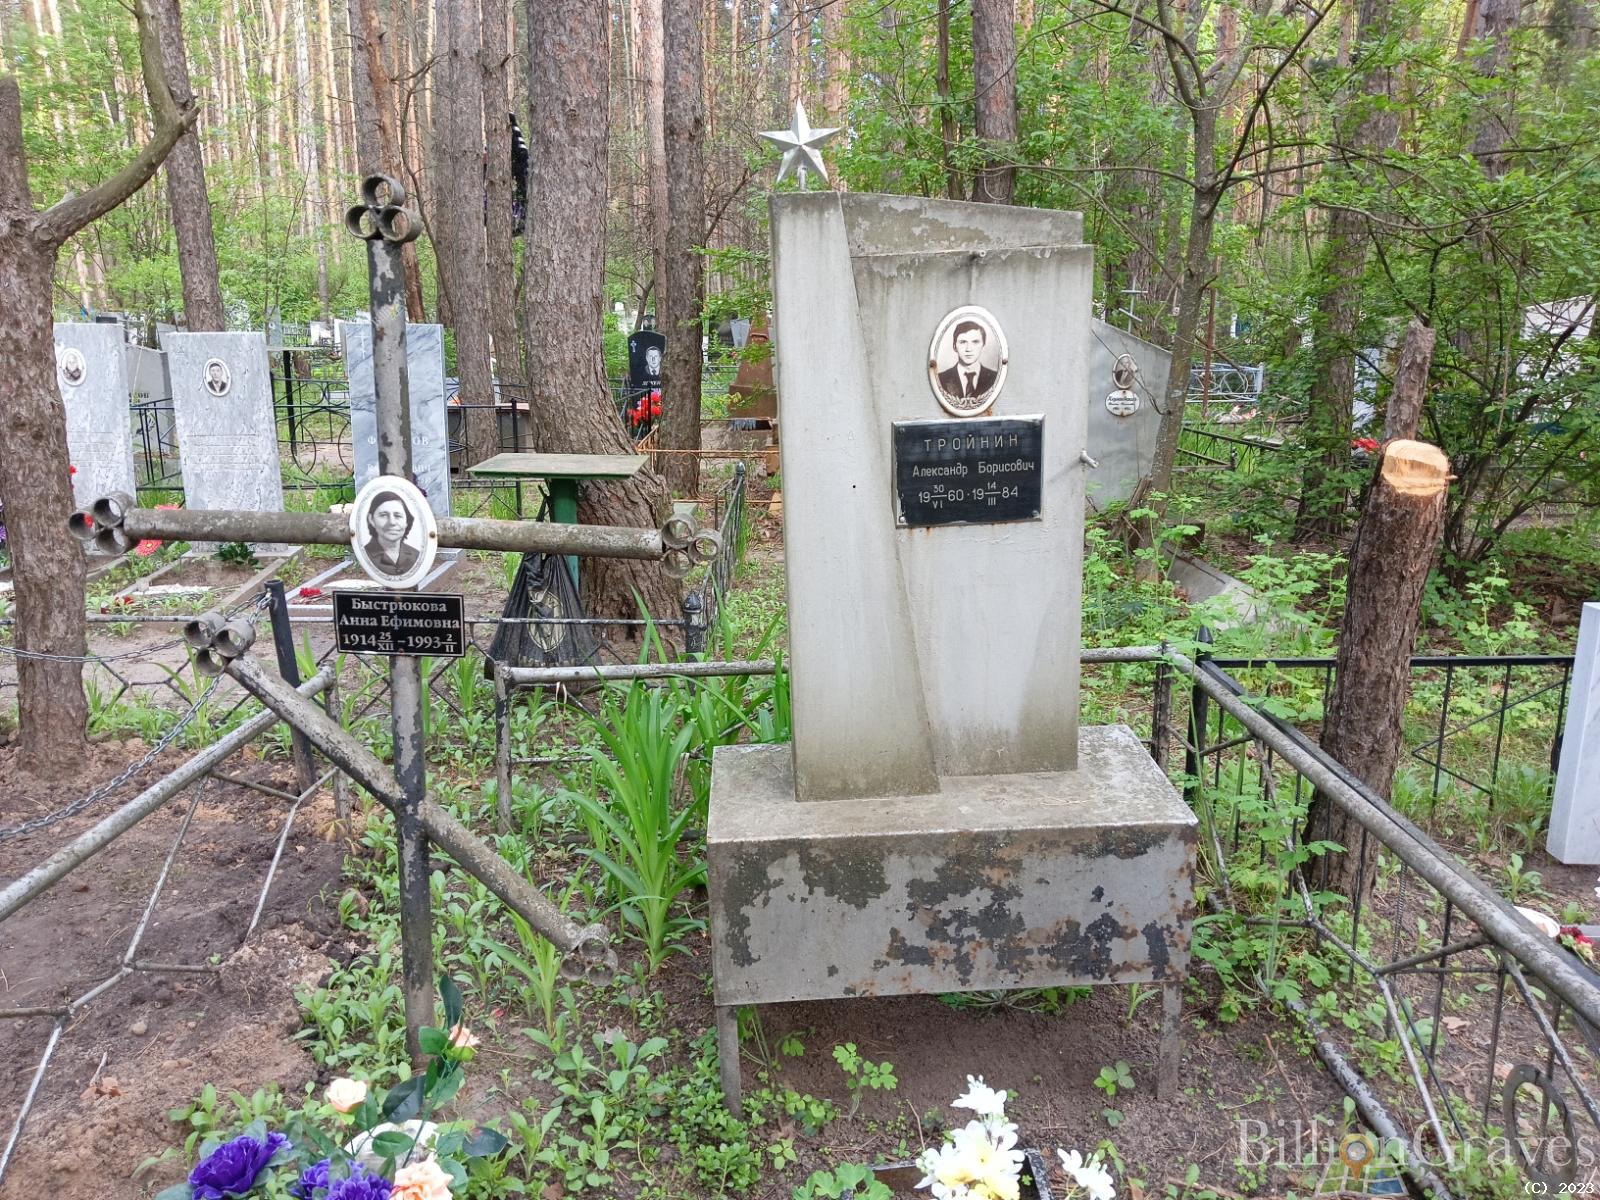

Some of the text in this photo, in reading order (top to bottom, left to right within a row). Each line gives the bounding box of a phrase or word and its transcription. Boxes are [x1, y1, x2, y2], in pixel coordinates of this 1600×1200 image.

[924, 434, 1018, 452] ТРОЙНИН
[912, 458, 1035, 478] Александр Борисович
[1001, 485, 1019, 499] 84
[351, 597, 448, 613] Быстрюкова
[339, 613, 460, 630] Анна Ефимовна
[343, 634, 377, 646] 1914
